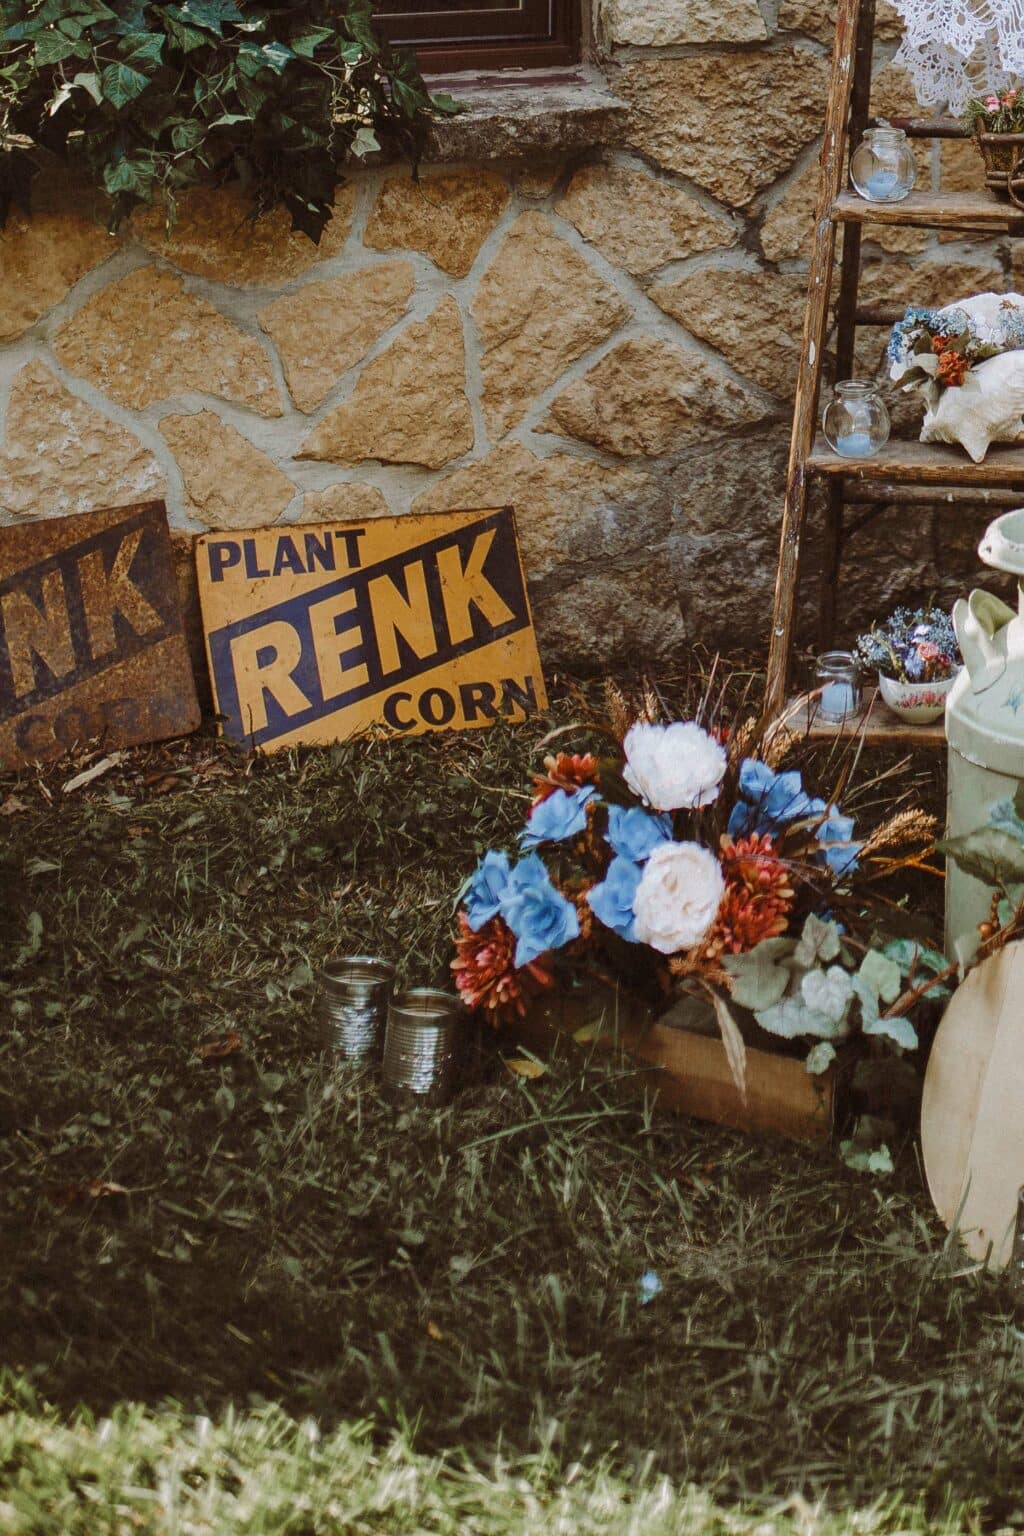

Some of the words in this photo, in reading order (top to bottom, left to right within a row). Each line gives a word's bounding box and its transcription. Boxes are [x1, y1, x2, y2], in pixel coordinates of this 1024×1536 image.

[207, 528, 366, 583] PLANT
[229, 527, 516, 736] RENK
[383, 675, 536, 731] CORN
